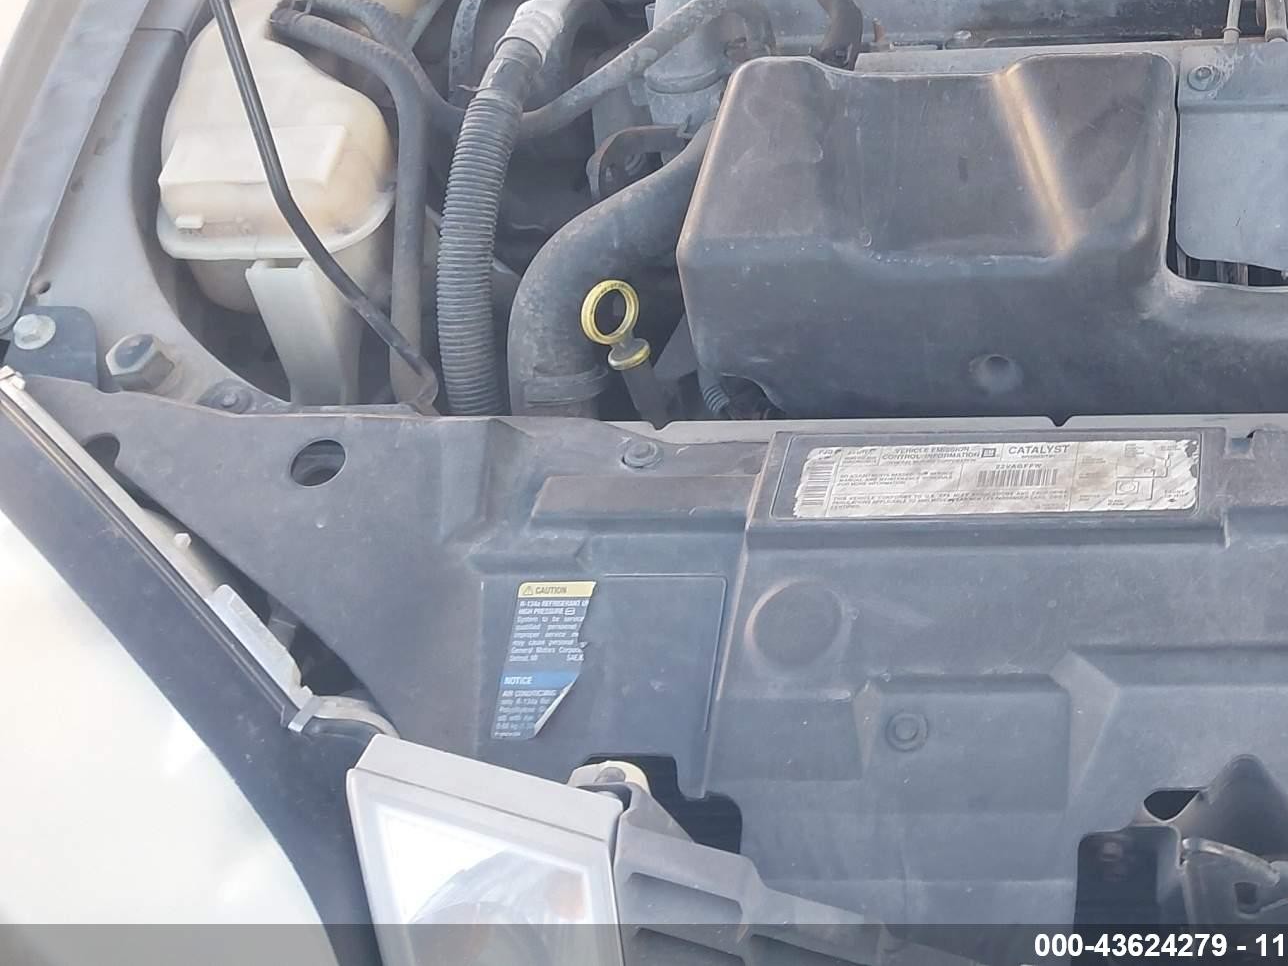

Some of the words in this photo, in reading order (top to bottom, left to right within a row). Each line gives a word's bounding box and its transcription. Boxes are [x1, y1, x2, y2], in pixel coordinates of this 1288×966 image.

[1008, 444, 1070, 454] CATALYST
[882, 452, 921, 460] CONTROL
[535, 586, 568, 594] CAUTION
[503, 676, 533, 685] NOTICE
